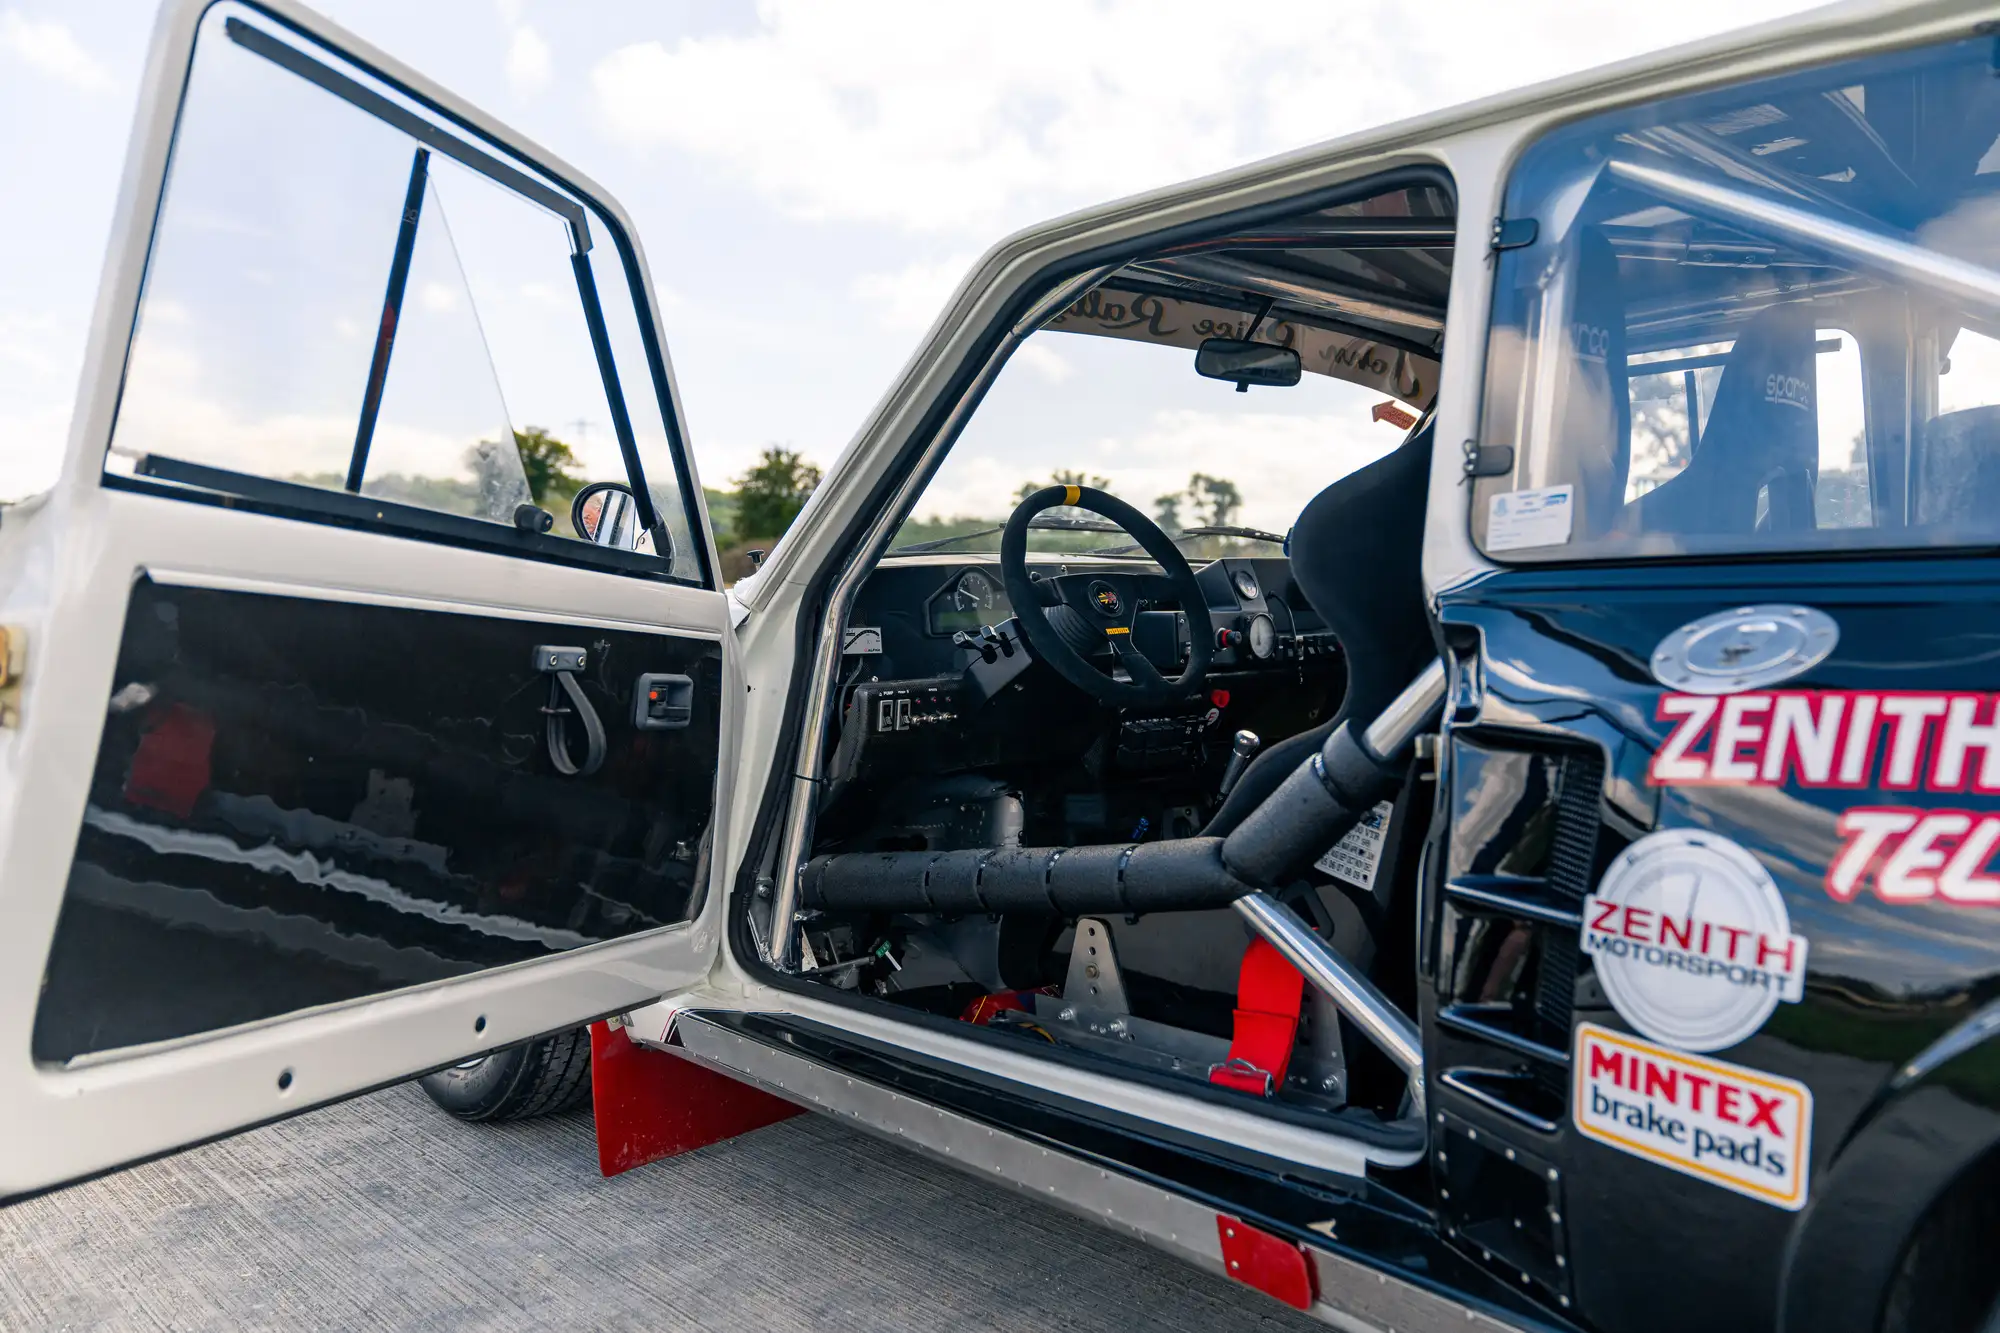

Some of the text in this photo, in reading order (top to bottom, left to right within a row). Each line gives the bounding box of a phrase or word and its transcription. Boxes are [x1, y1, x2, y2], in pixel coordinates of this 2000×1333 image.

[1648, 690, 2000, 794] ZENITH
[1588, 932, 1791, 992] MOTORSPORT
[1590, 900, 1795, 973] ZENITH
[1591, 1043, 1785, 1138] MINTEX
[1592, 1083, 1786, 1177] brake pads
